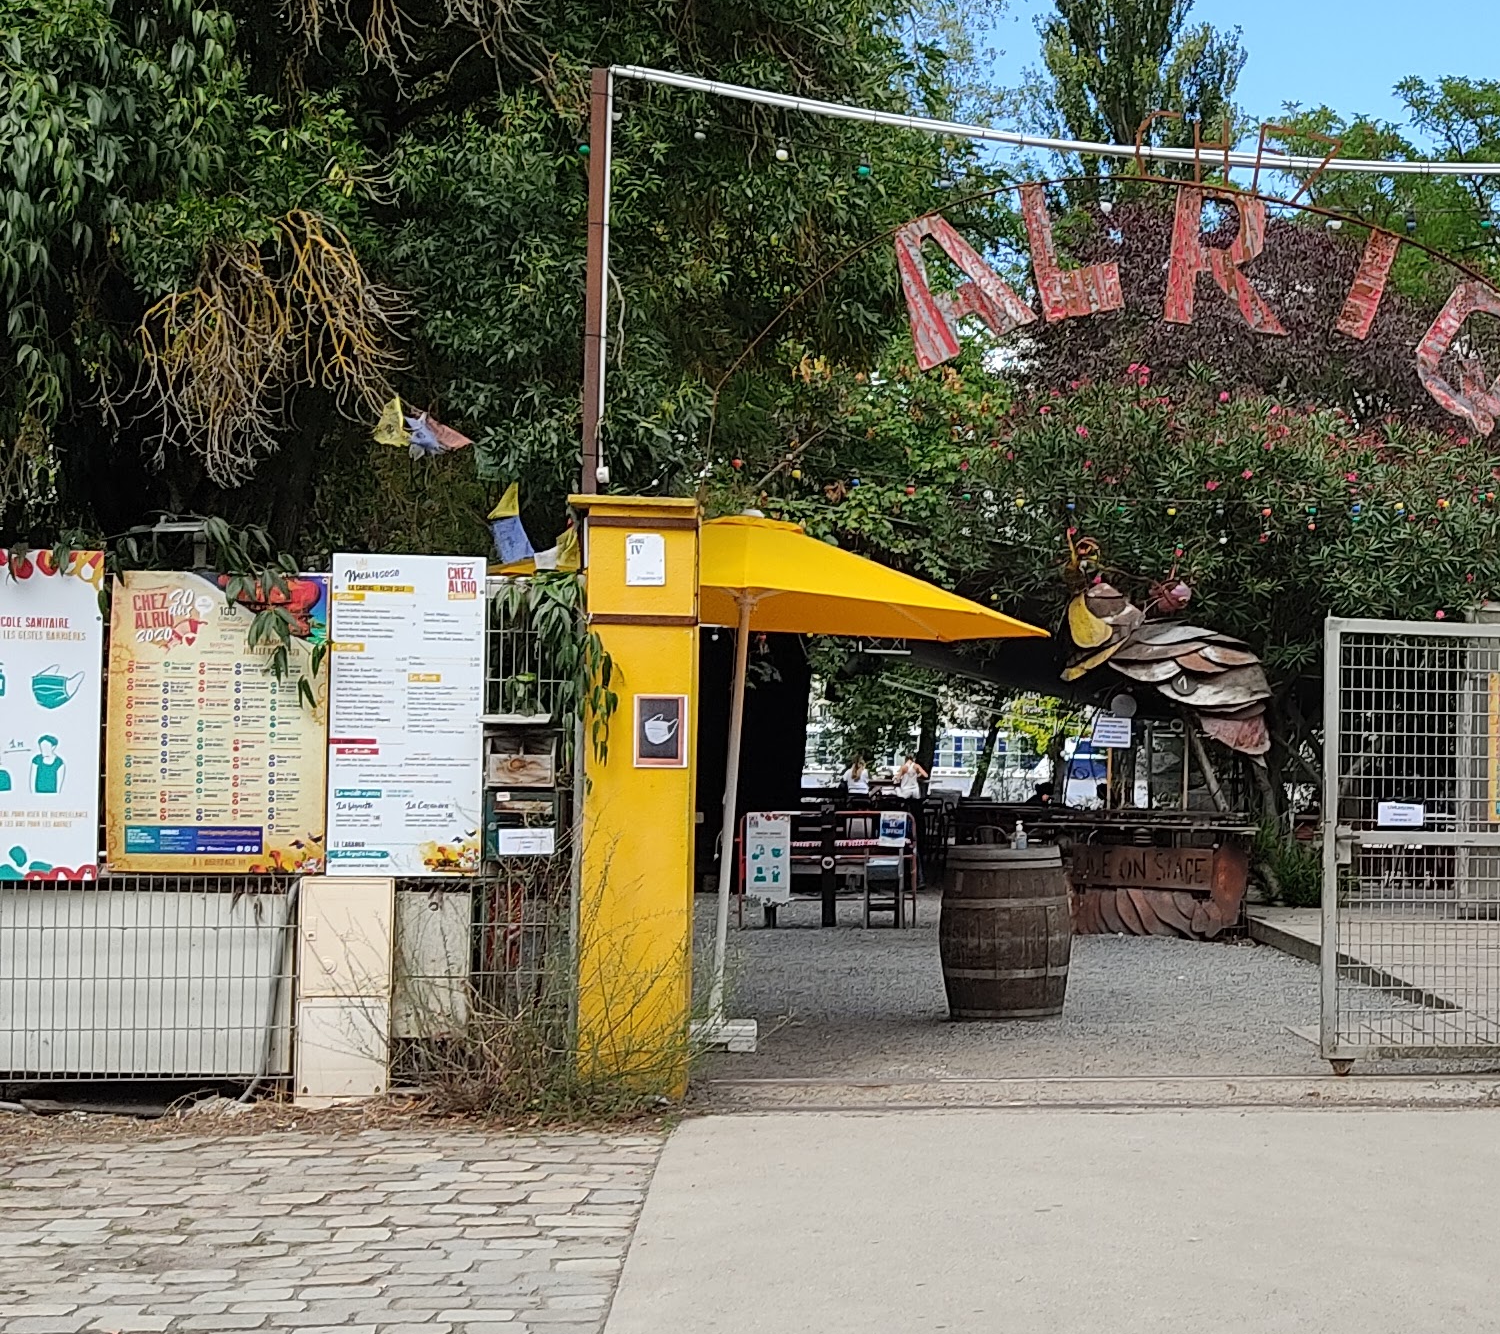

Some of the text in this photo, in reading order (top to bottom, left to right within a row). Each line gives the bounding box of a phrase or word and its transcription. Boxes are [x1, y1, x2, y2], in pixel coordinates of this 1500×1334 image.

[1136, 110, 1343, 202] CHEZ
[448, 567, 474, 580] CHEZ
[133, 593, 169, 611] CHEZ
[169, 588, 195, 607] 30
[26, 616, 70, 629] SANITAIRE
[136, 627, 173, 643] 2020
[1119, 852, 1147, 881] ON
